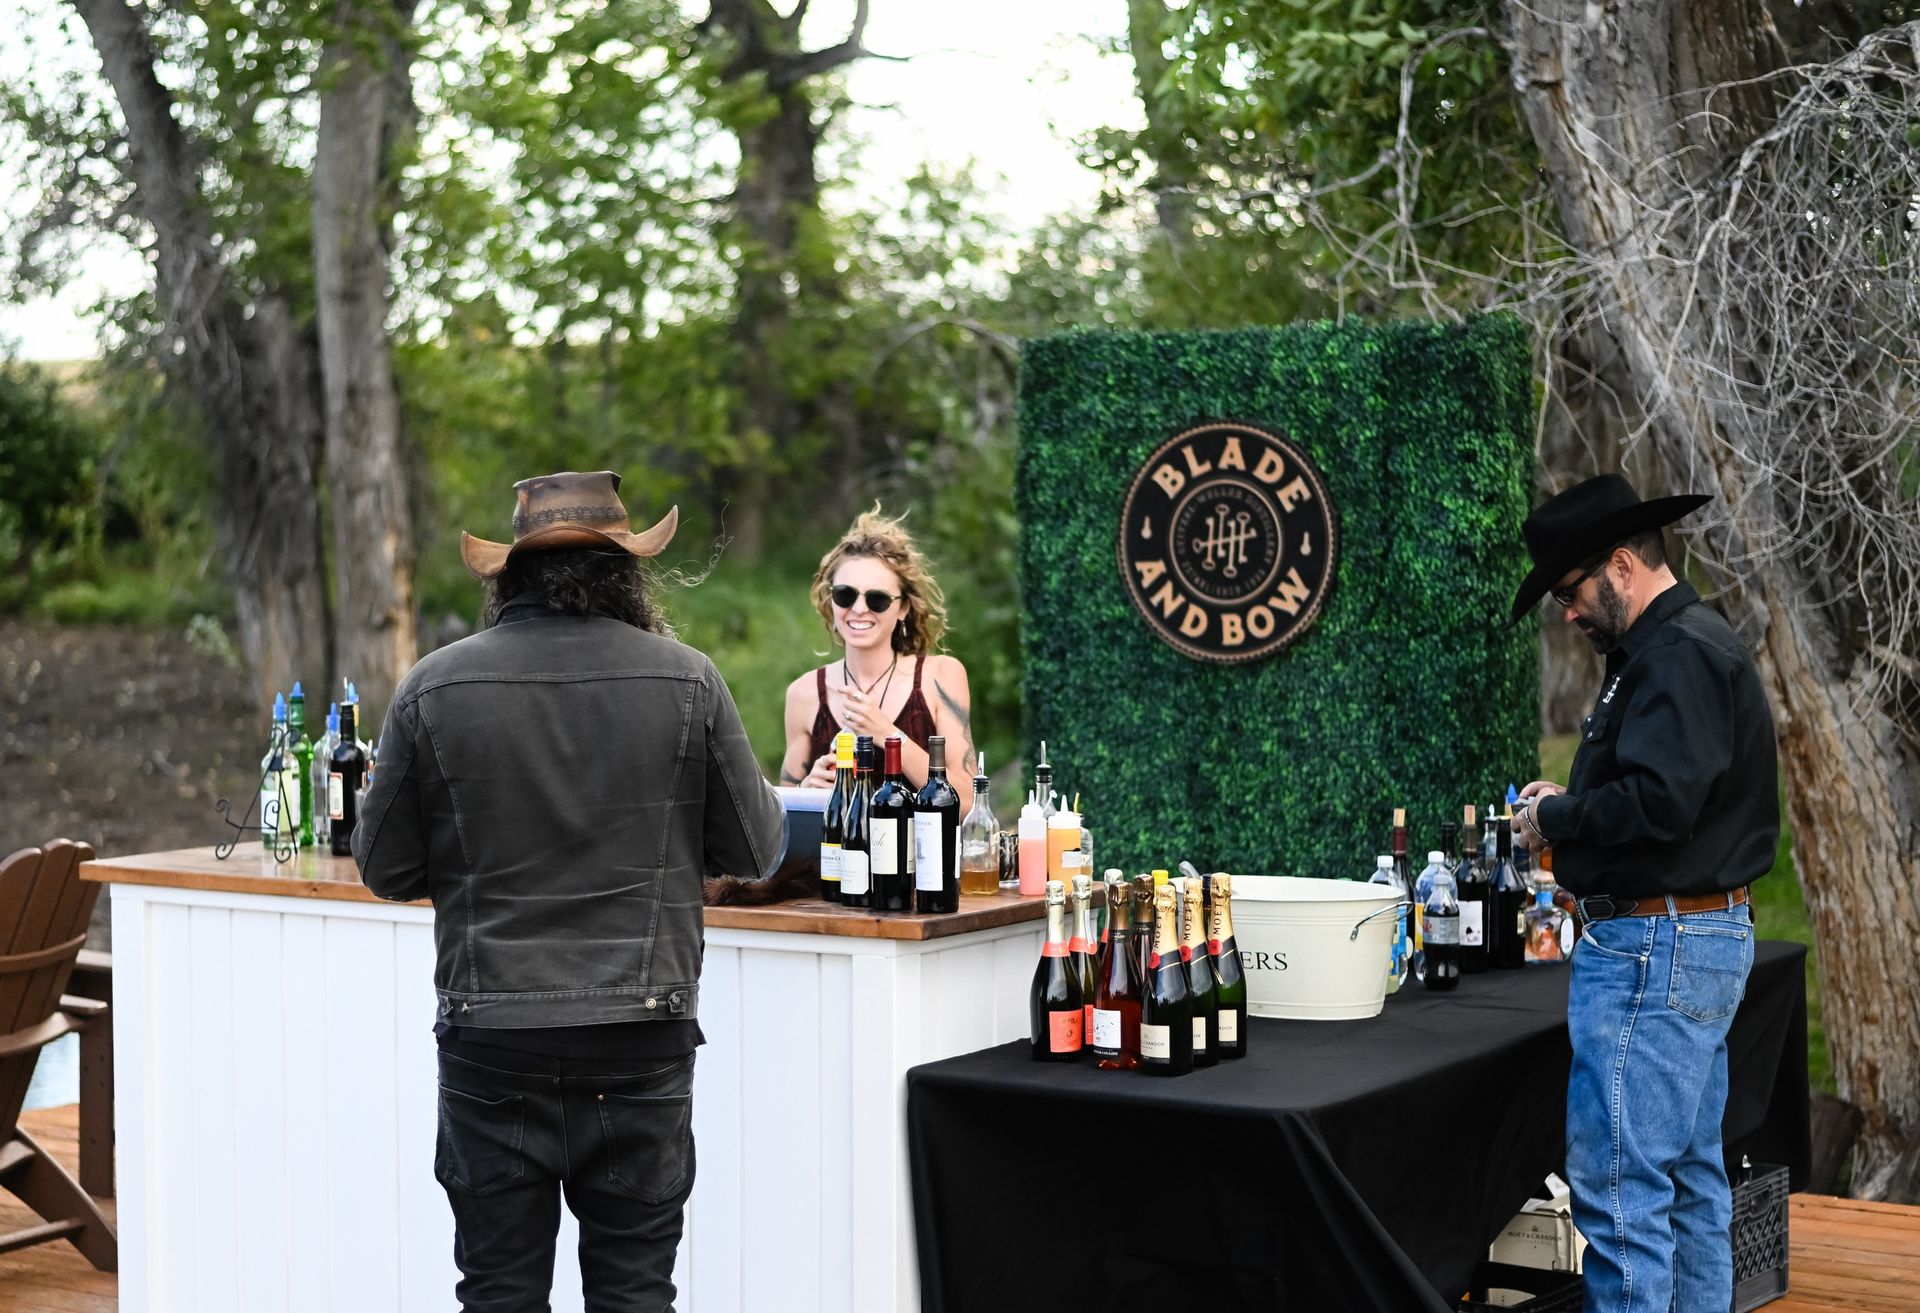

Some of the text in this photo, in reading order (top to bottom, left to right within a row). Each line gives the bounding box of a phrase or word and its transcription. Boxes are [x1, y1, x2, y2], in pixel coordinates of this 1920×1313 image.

[1151, 436, 1312, 514] BLADE
[1135, 559, 1311, 647] AND BOW
[1240, 951, 1288, 971] ERS
